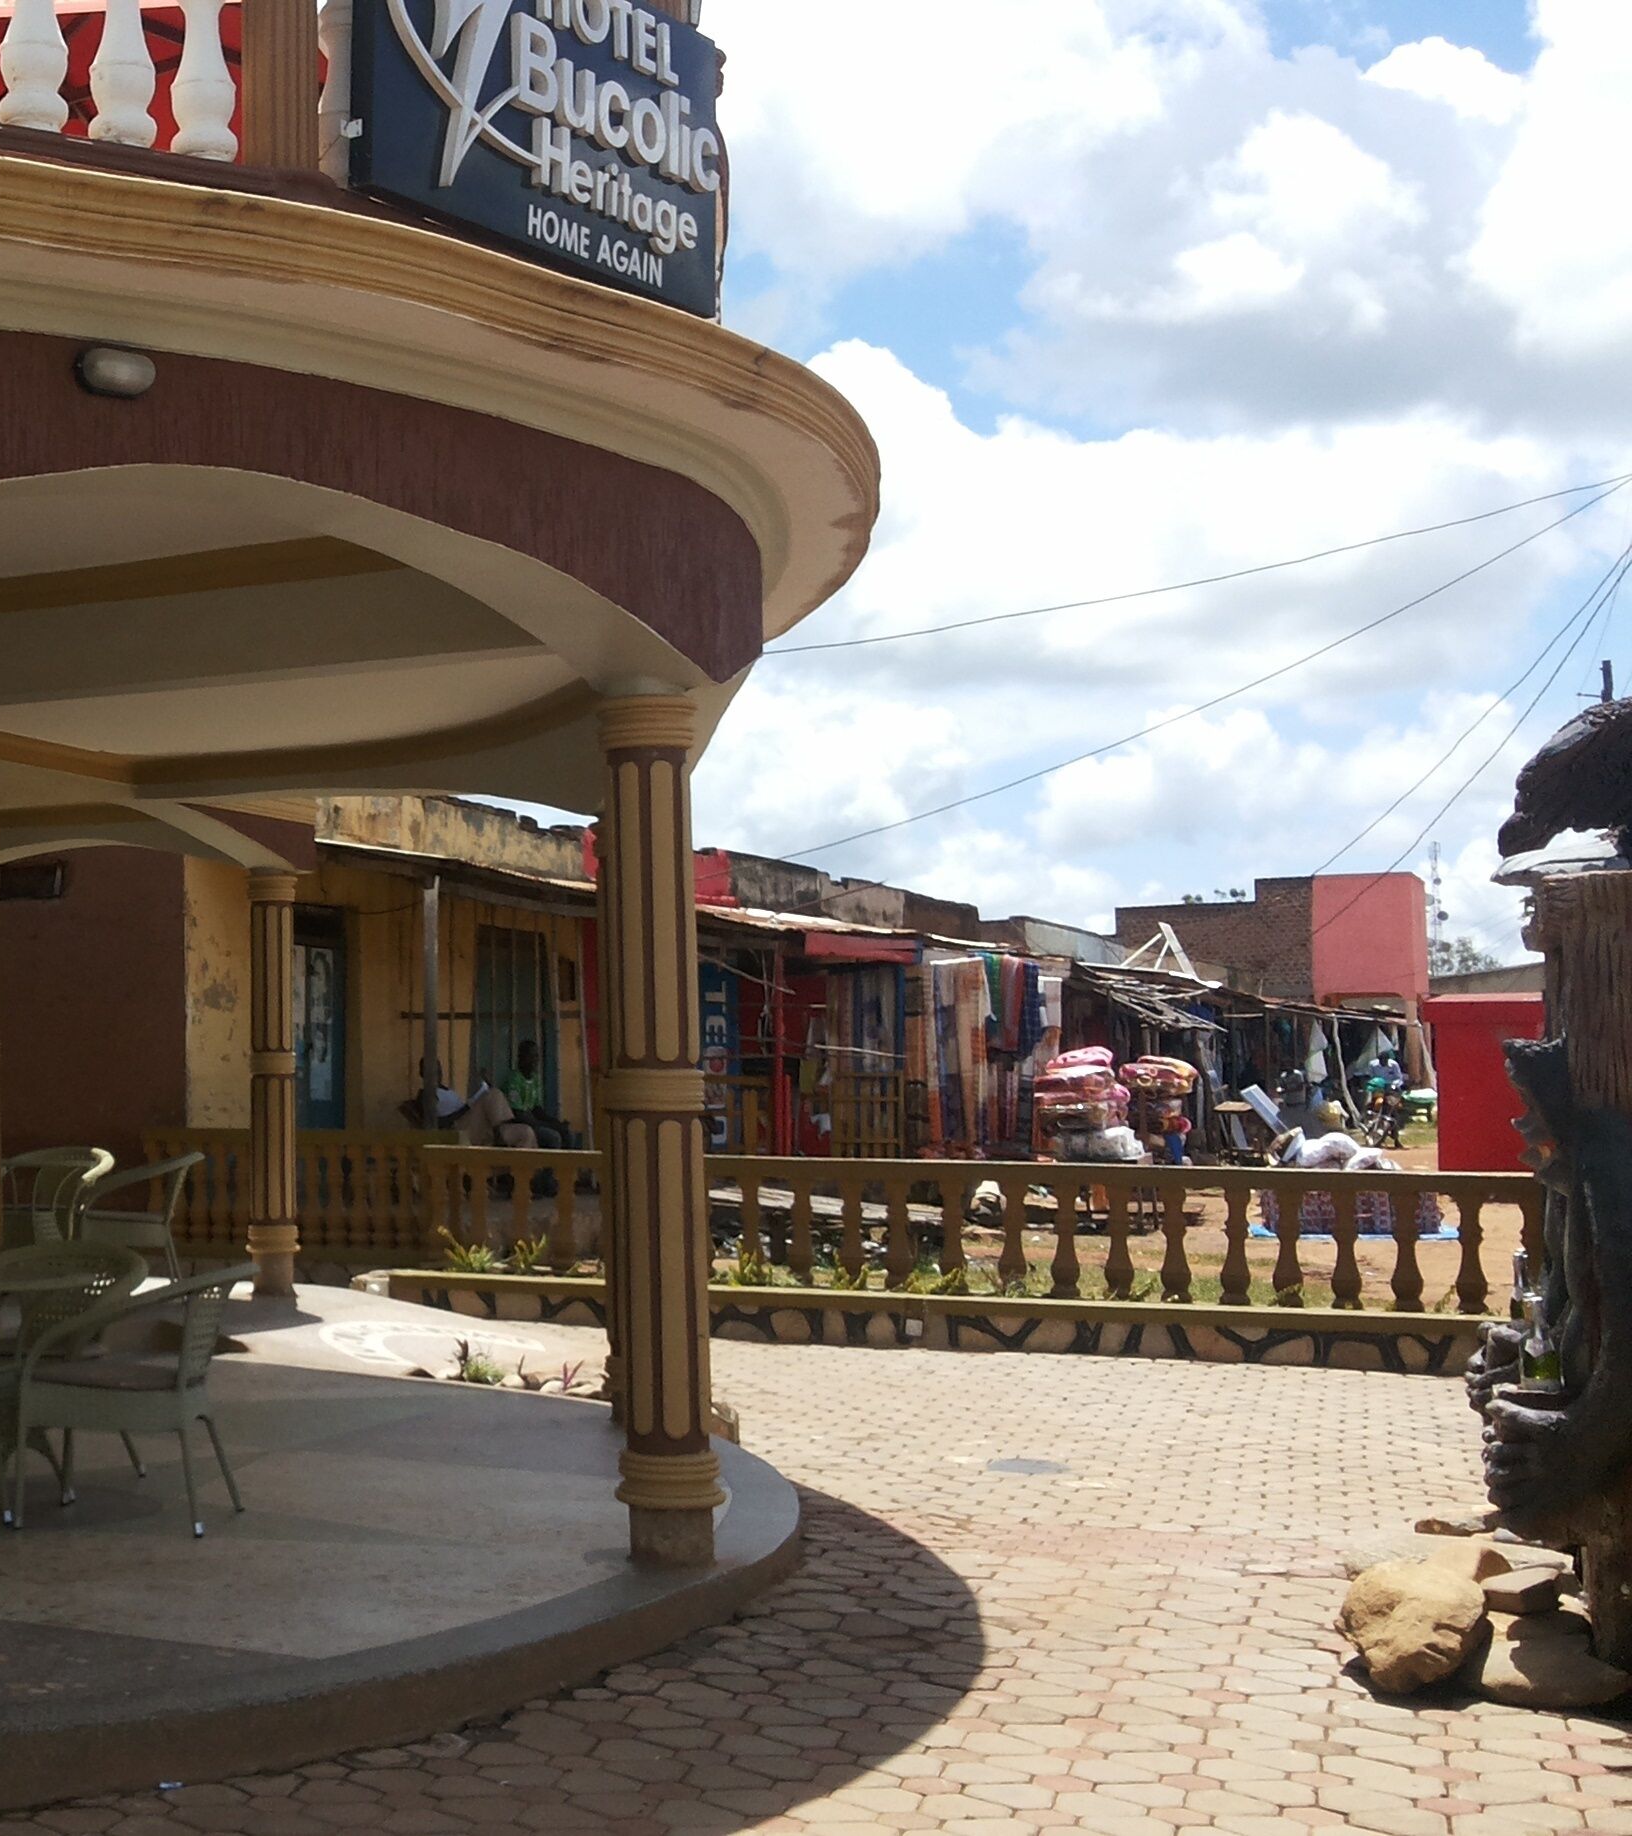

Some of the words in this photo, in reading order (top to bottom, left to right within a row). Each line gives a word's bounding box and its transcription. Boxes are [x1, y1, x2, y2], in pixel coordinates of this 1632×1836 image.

[510, 12, 720, 192] Bucolic
[528, 203, 590, 259] HOME
[596, 234, 663, 288] AGAIN
[531, 116, 698, 254] Heritage
